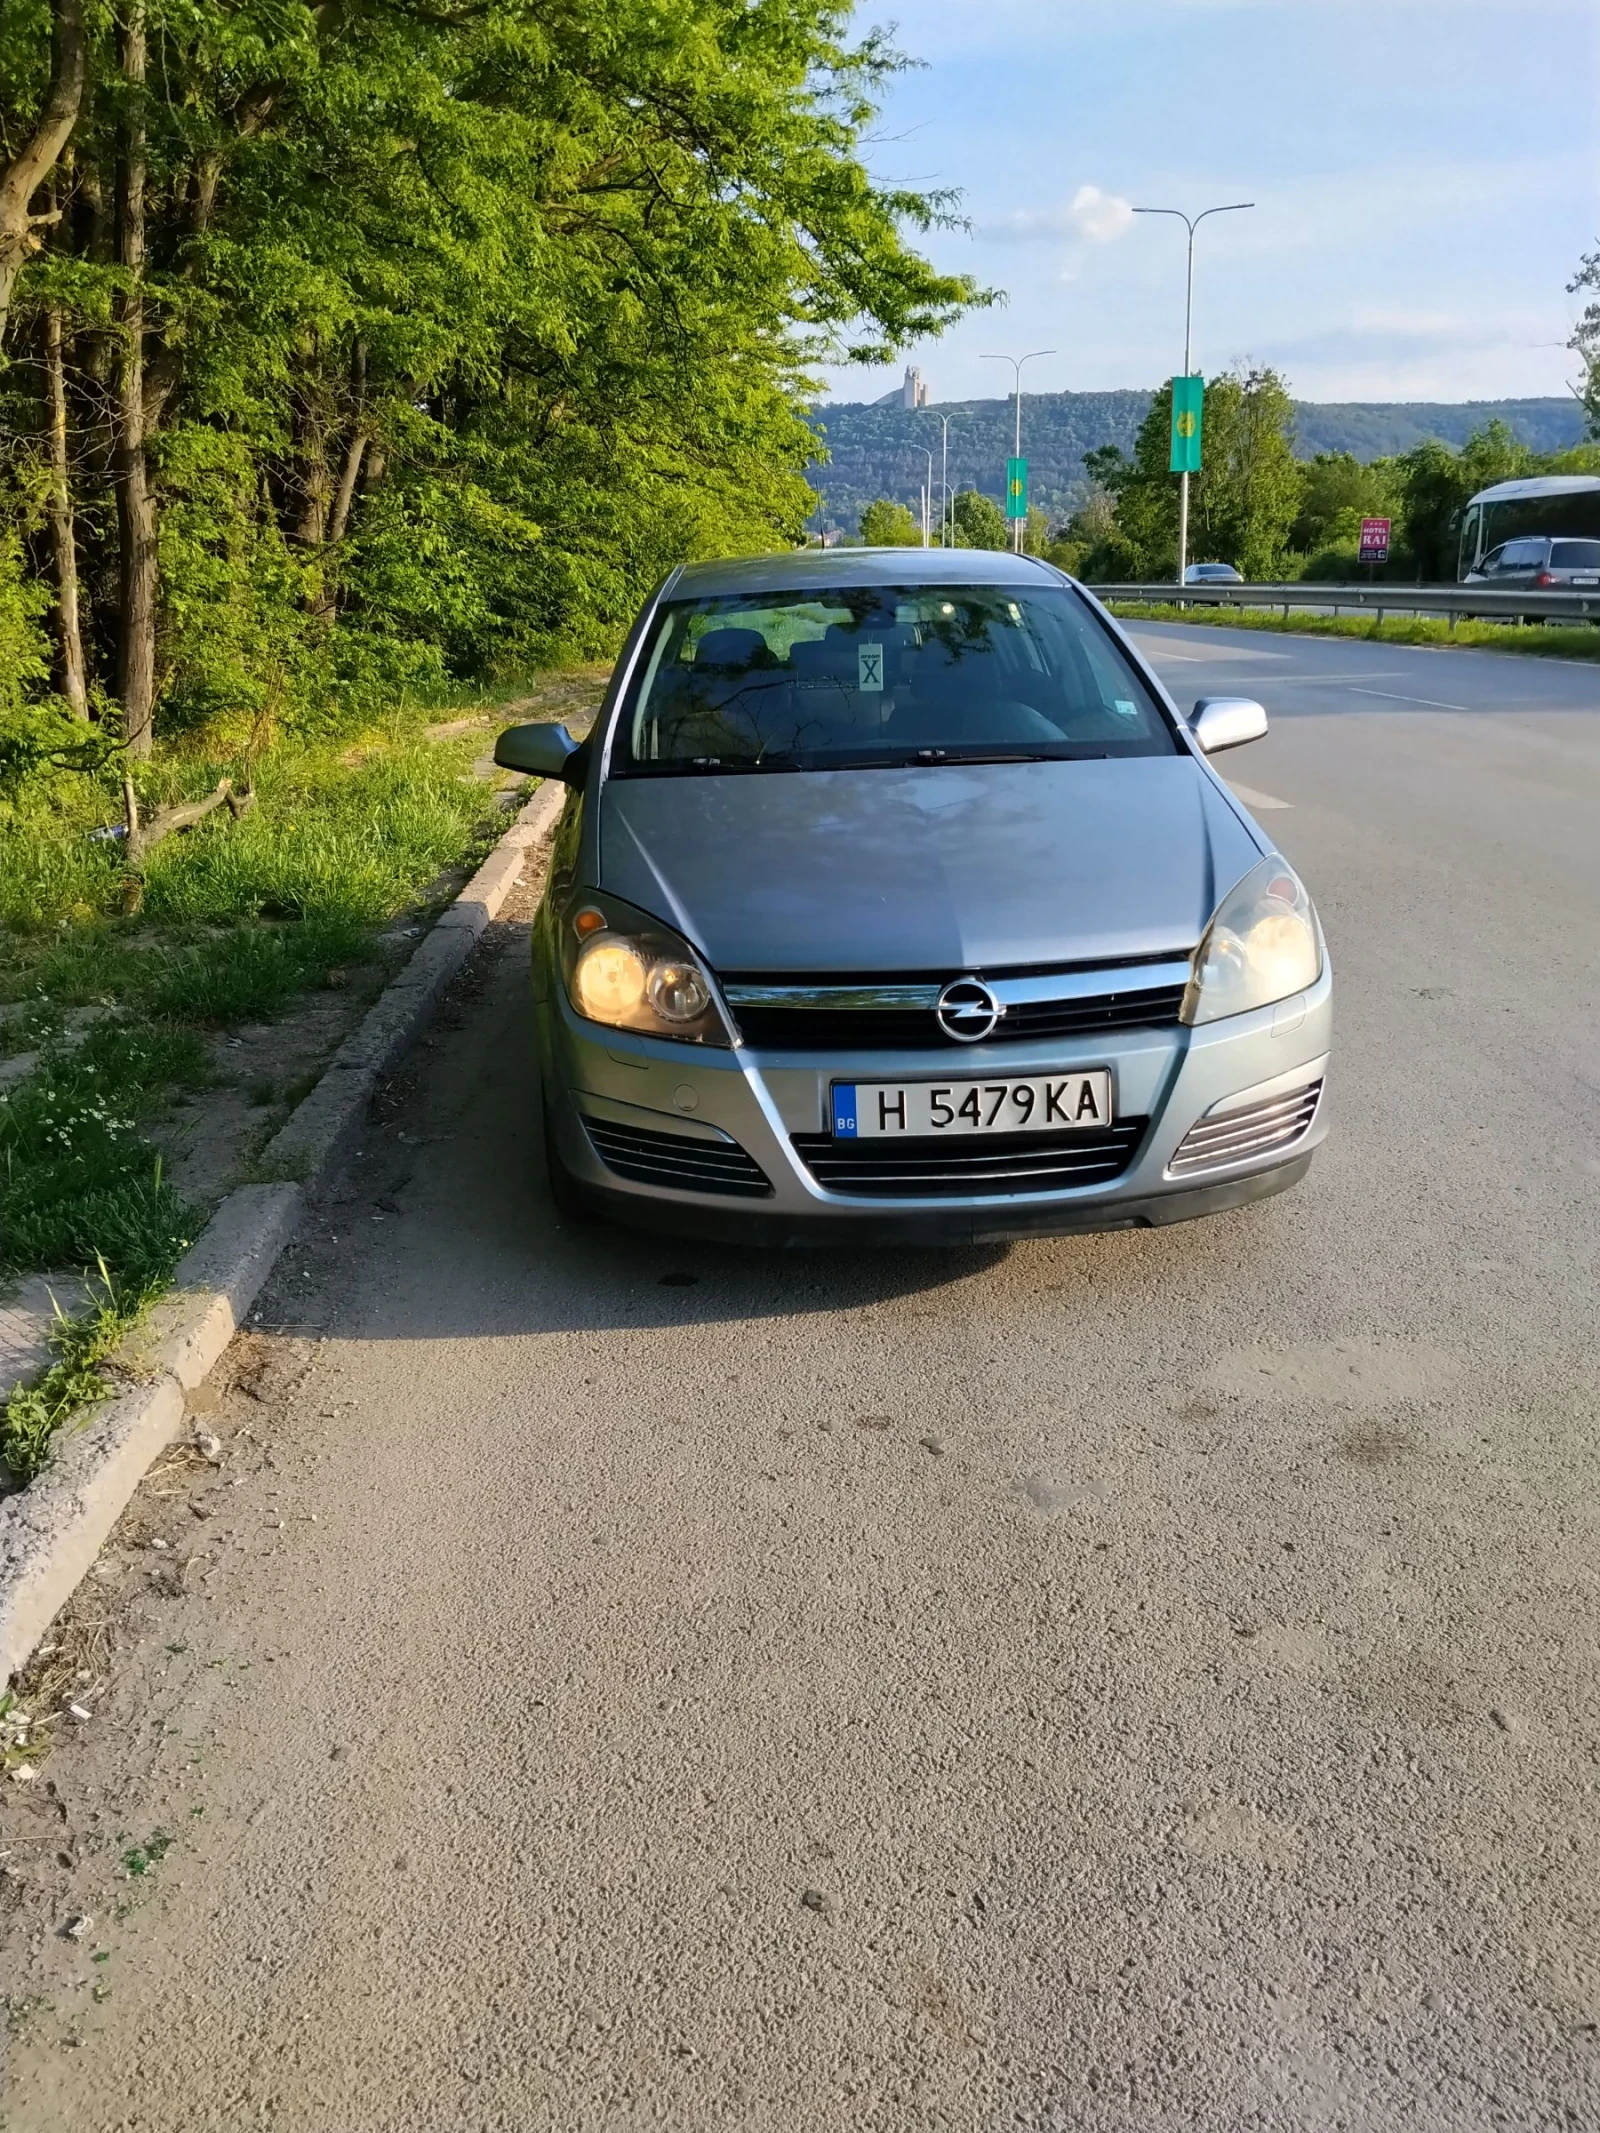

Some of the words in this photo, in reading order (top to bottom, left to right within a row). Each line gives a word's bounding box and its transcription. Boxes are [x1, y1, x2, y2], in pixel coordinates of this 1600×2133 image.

[1362, 535, 1386, 545] RAI
[861, 660, 880, 684] X
[878, 1090, 907, 1131] H
[837, 1118, 855, 1130] BG
